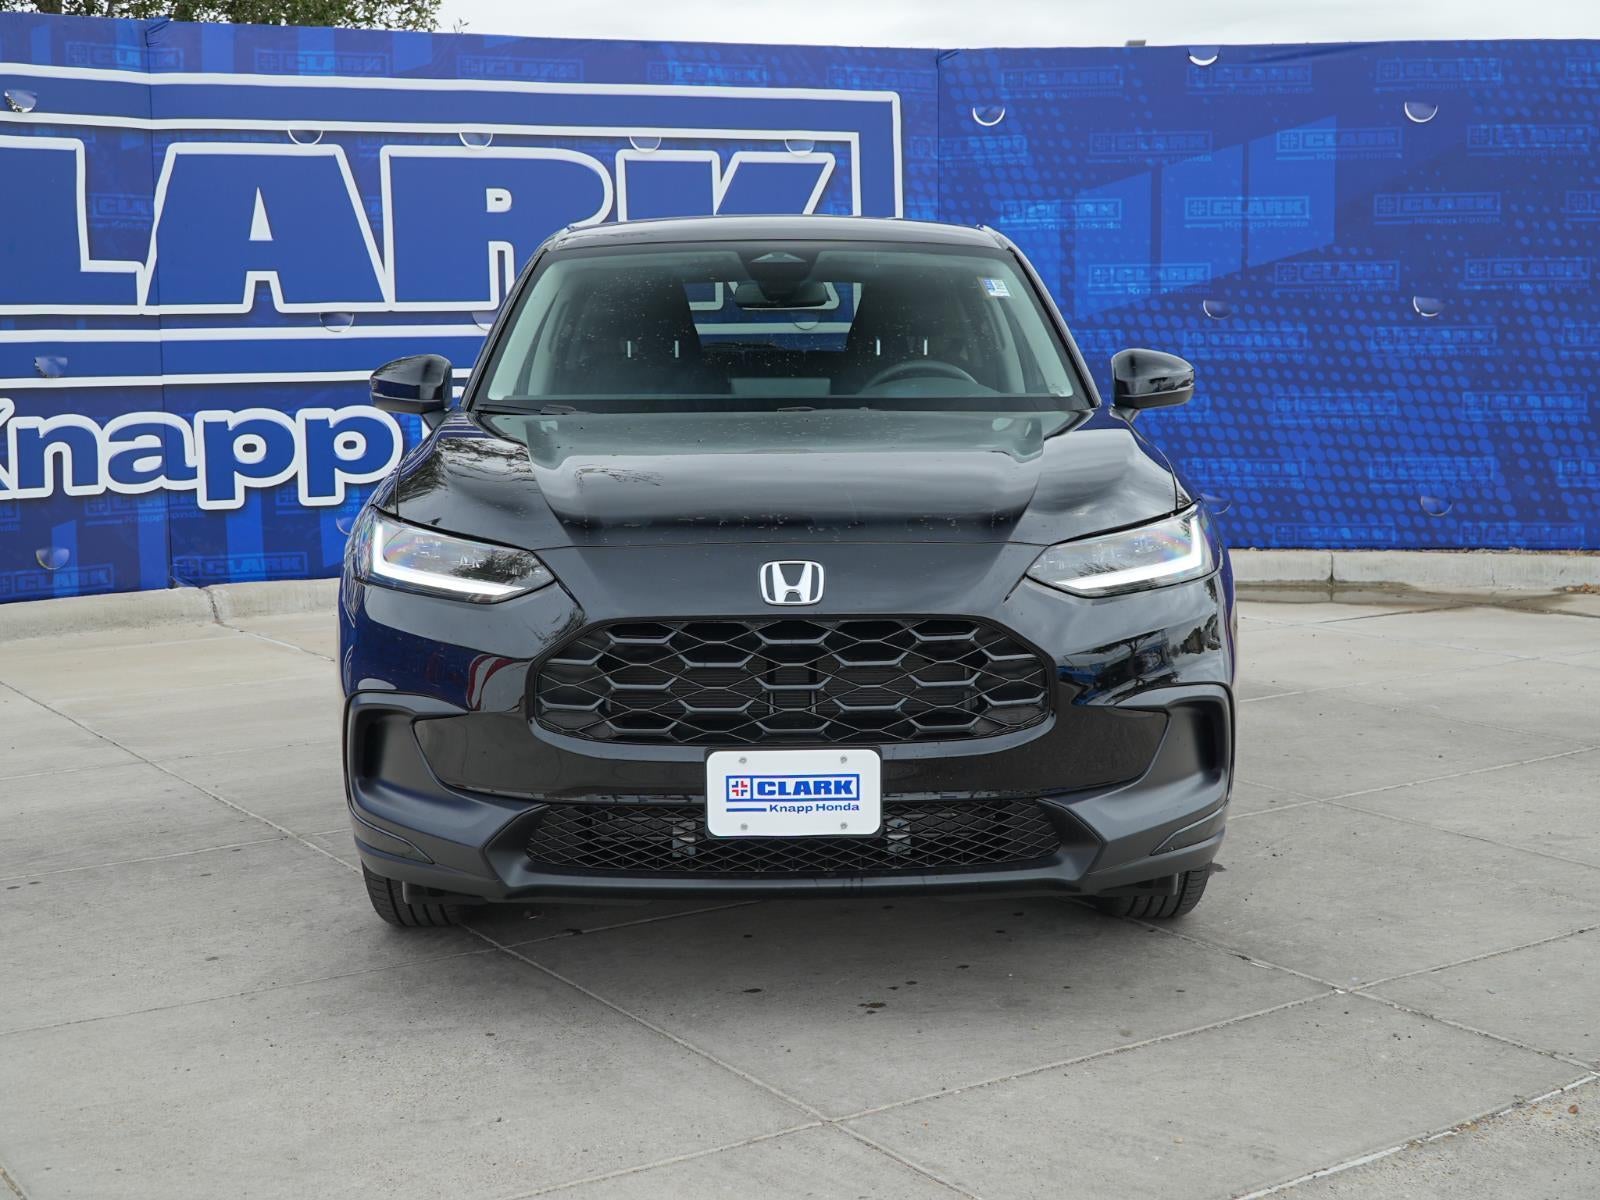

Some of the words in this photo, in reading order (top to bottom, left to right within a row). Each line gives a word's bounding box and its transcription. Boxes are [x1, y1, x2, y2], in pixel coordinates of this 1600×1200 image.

[1305, 132, 1396, 147] CLARK
[1213, 202, 1304, 216] CLARK
[757, 779, 854, 797] CLARK
[769, 803, 813, 814] Knapp
[815, 802, 860, 813] Honda
